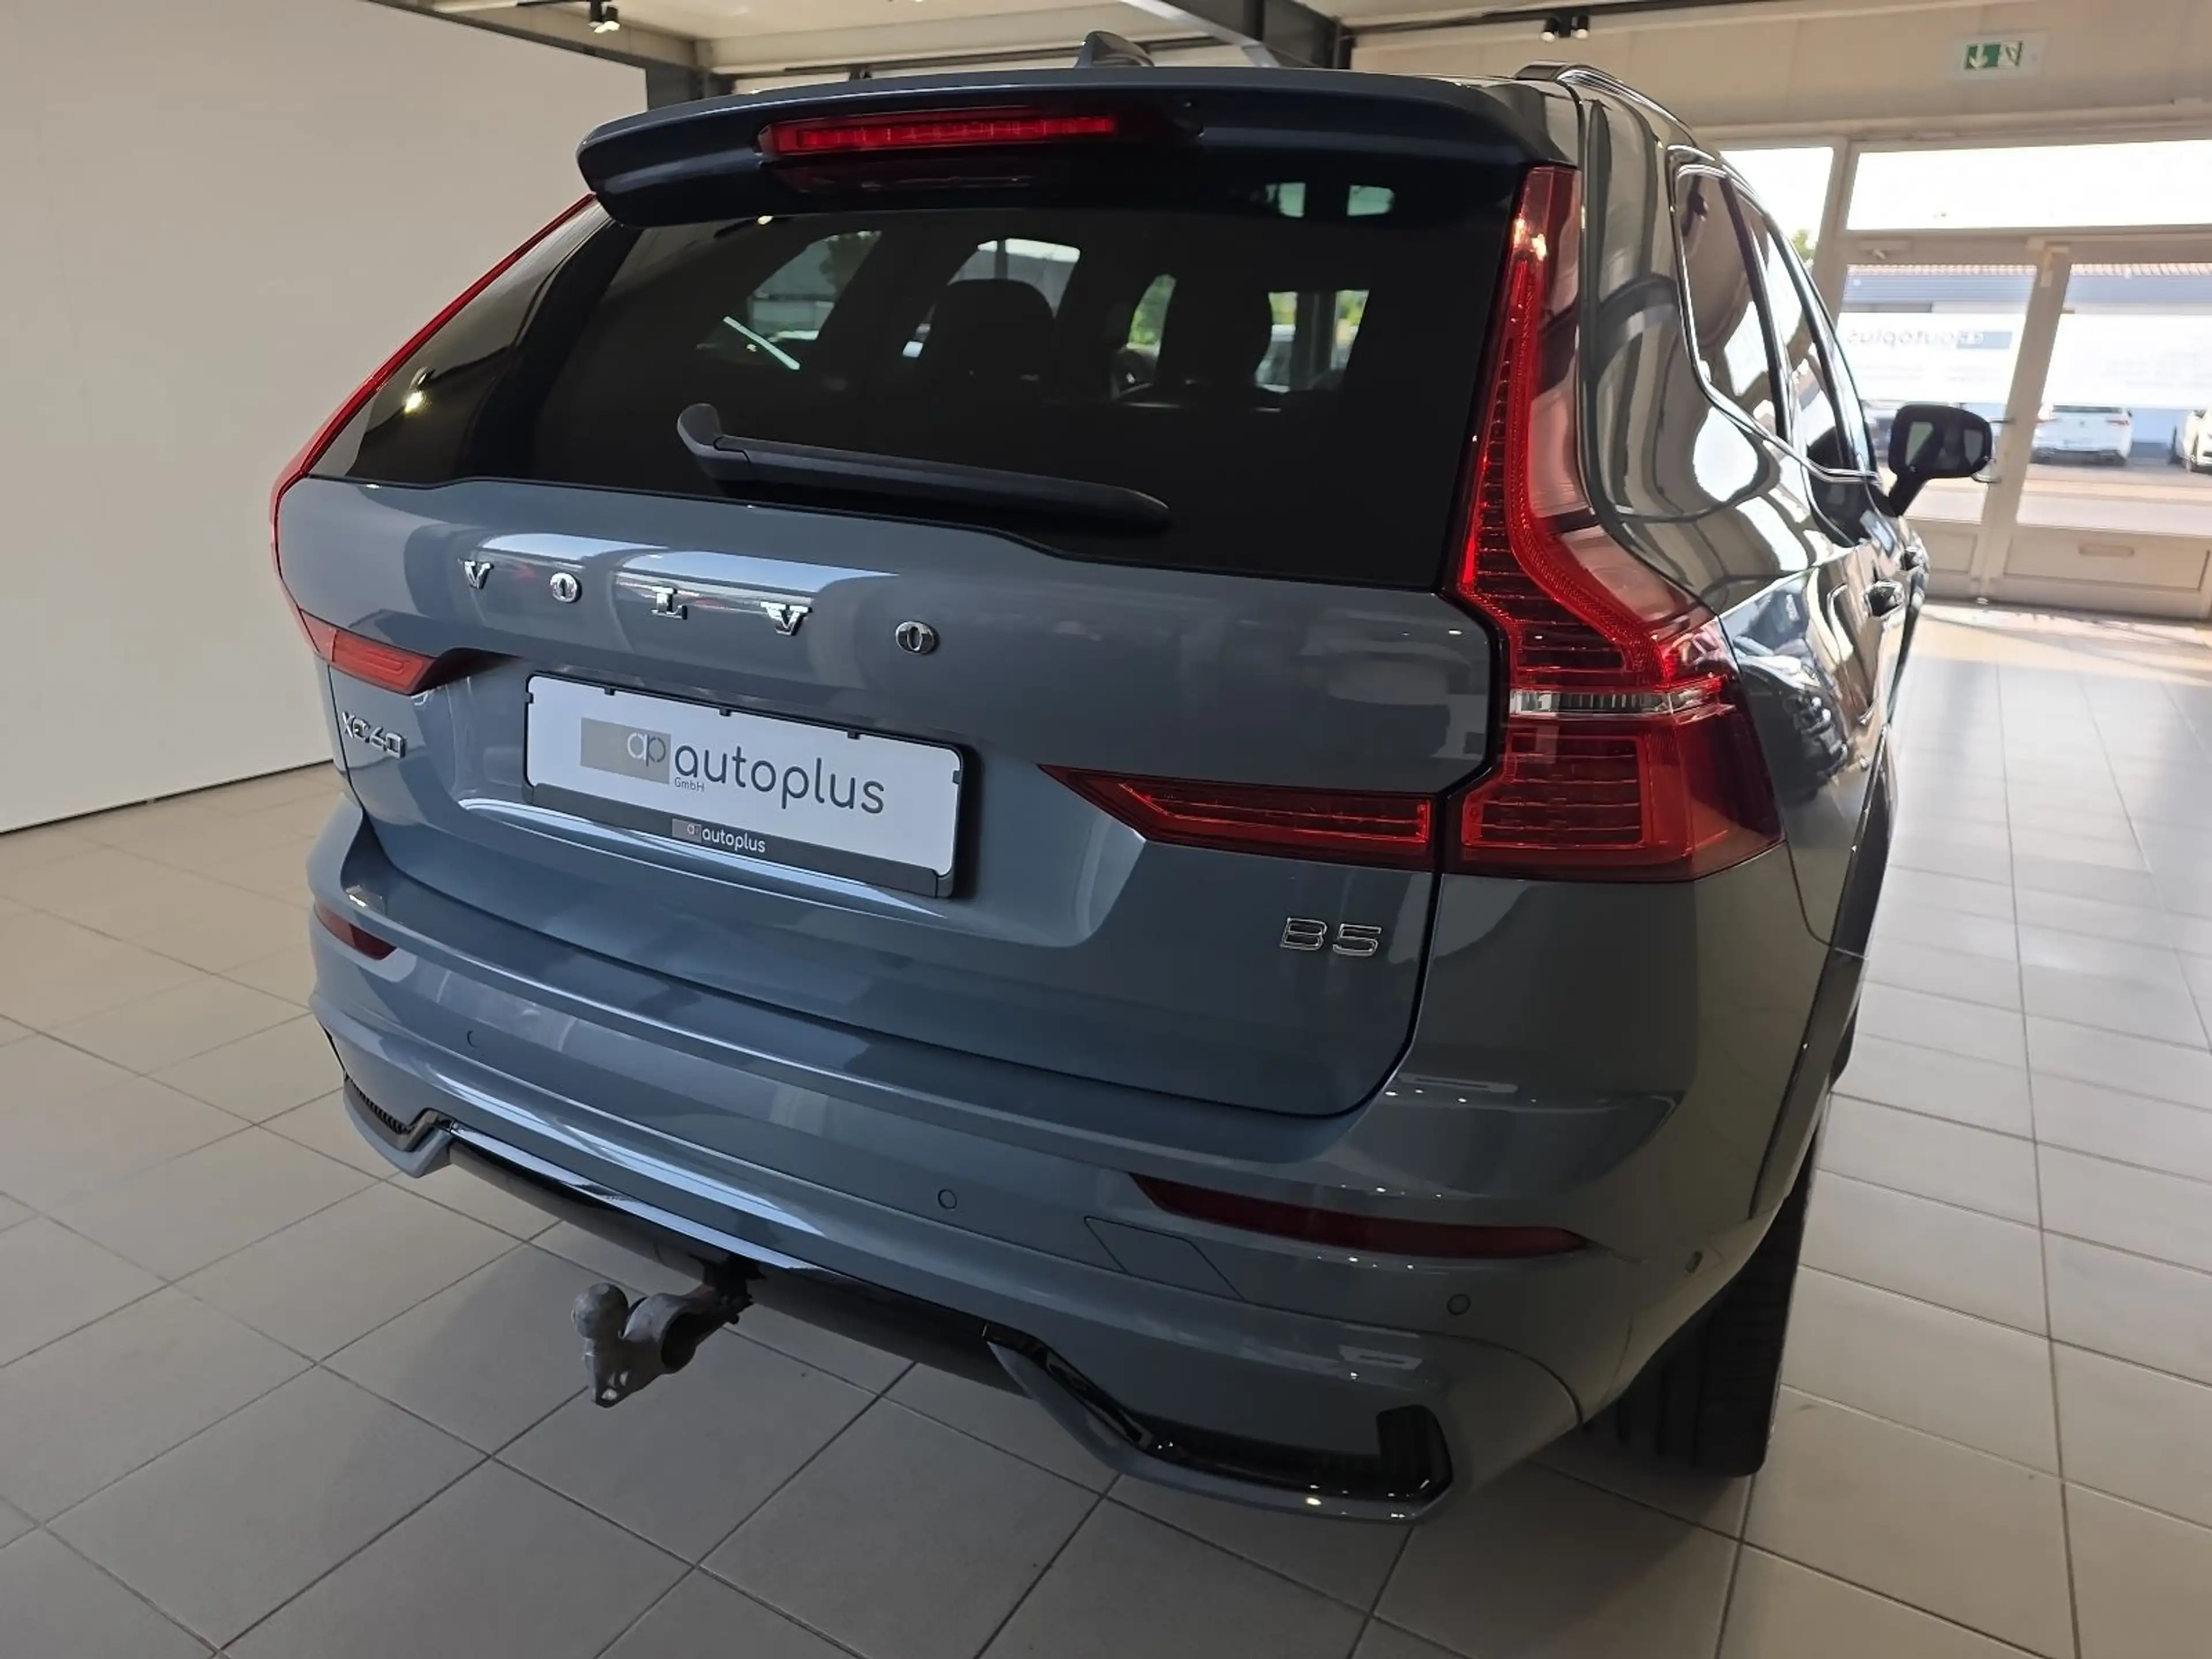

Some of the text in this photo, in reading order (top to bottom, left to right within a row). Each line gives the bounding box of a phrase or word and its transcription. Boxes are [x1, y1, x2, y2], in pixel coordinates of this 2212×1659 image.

[463, 560, 938, 654] VOLVO
[342, 711, 406, 758] XC60
[674, 744, 885, 814] autoplus
[674, 777, 705, 793] GmbH
[702, 825, 766, 853] autoplus
[1279, 917, 1382, 956] B5
